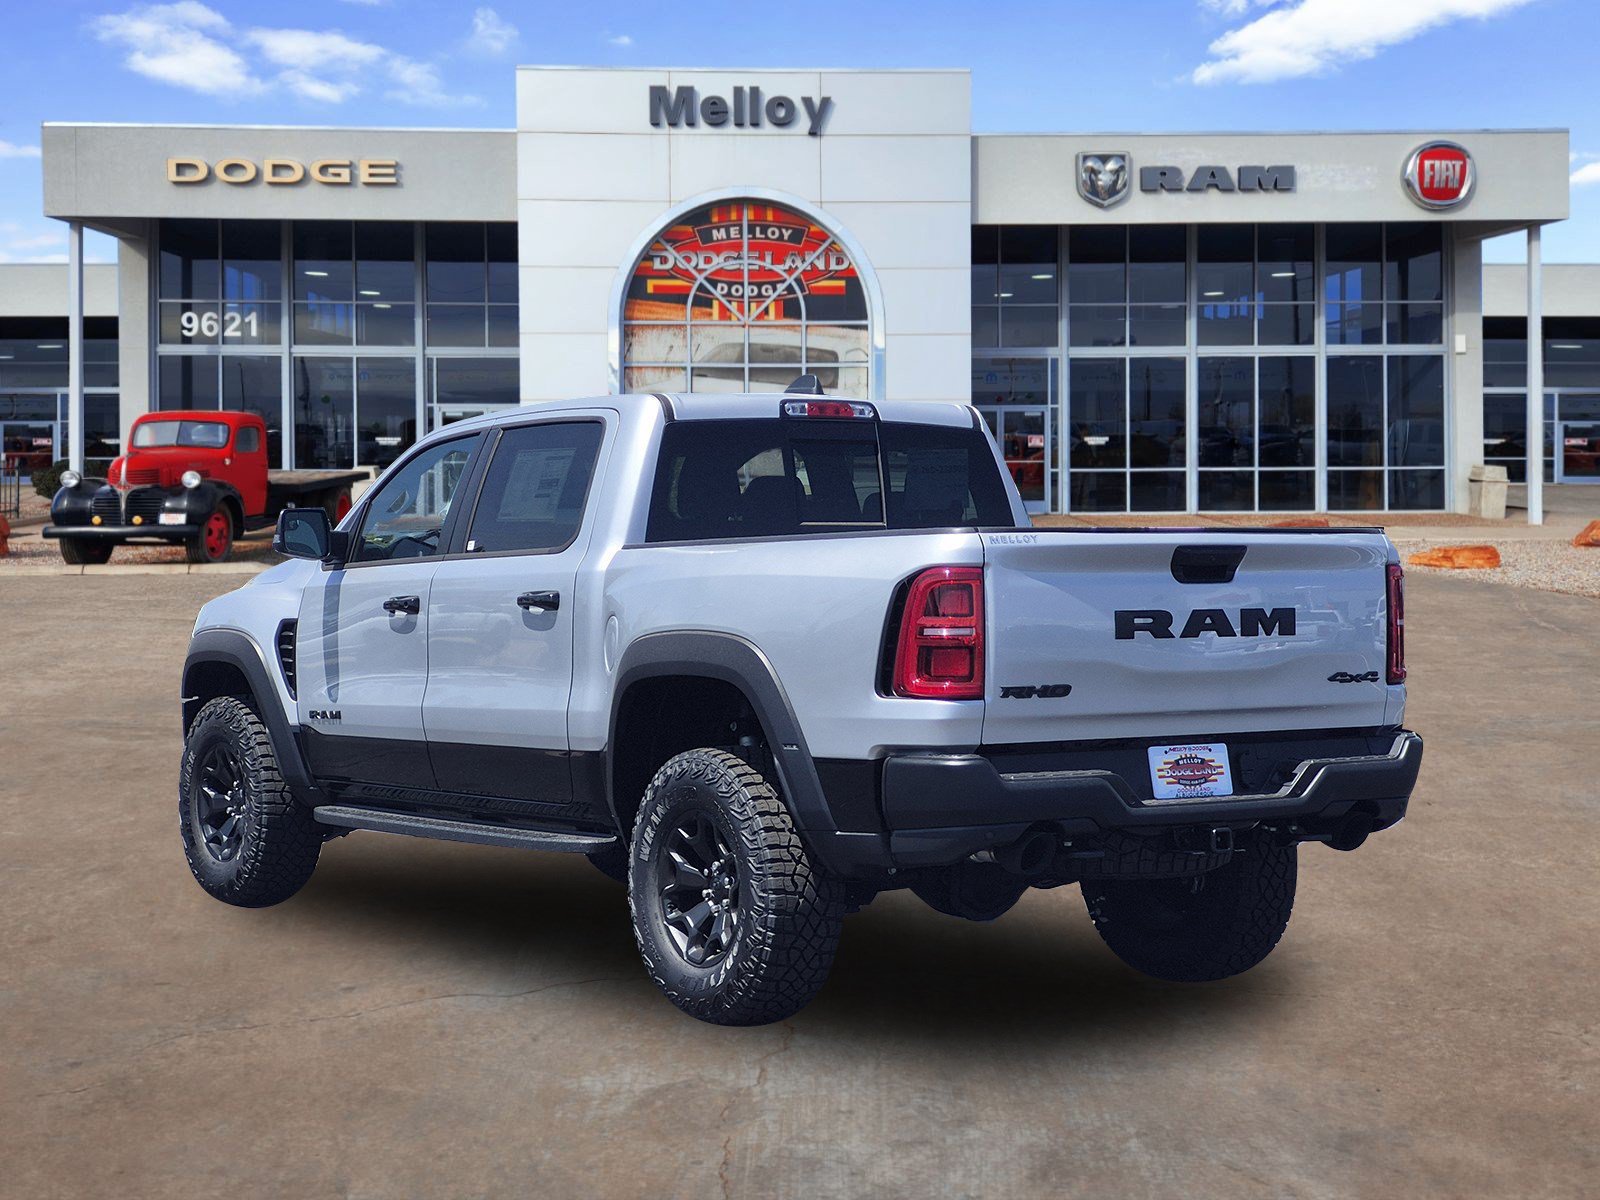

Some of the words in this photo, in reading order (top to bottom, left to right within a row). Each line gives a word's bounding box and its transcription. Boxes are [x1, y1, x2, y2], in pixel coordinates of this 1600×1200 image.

[649, 85, 832, 136] Melloy
[167, 158, 399, 185] DODGE
[1140, 165, 1296, 192] RAM
[1423, 160, 1463, 188] FIAT
[717, 282, 788, 297] DODGE
[181, 311, 257, 337] 9621
[1115, 608, 1296, 640] RAM
[1000, 684, 1072, 699] RHO
[309, 710, 342, 720] RAM
